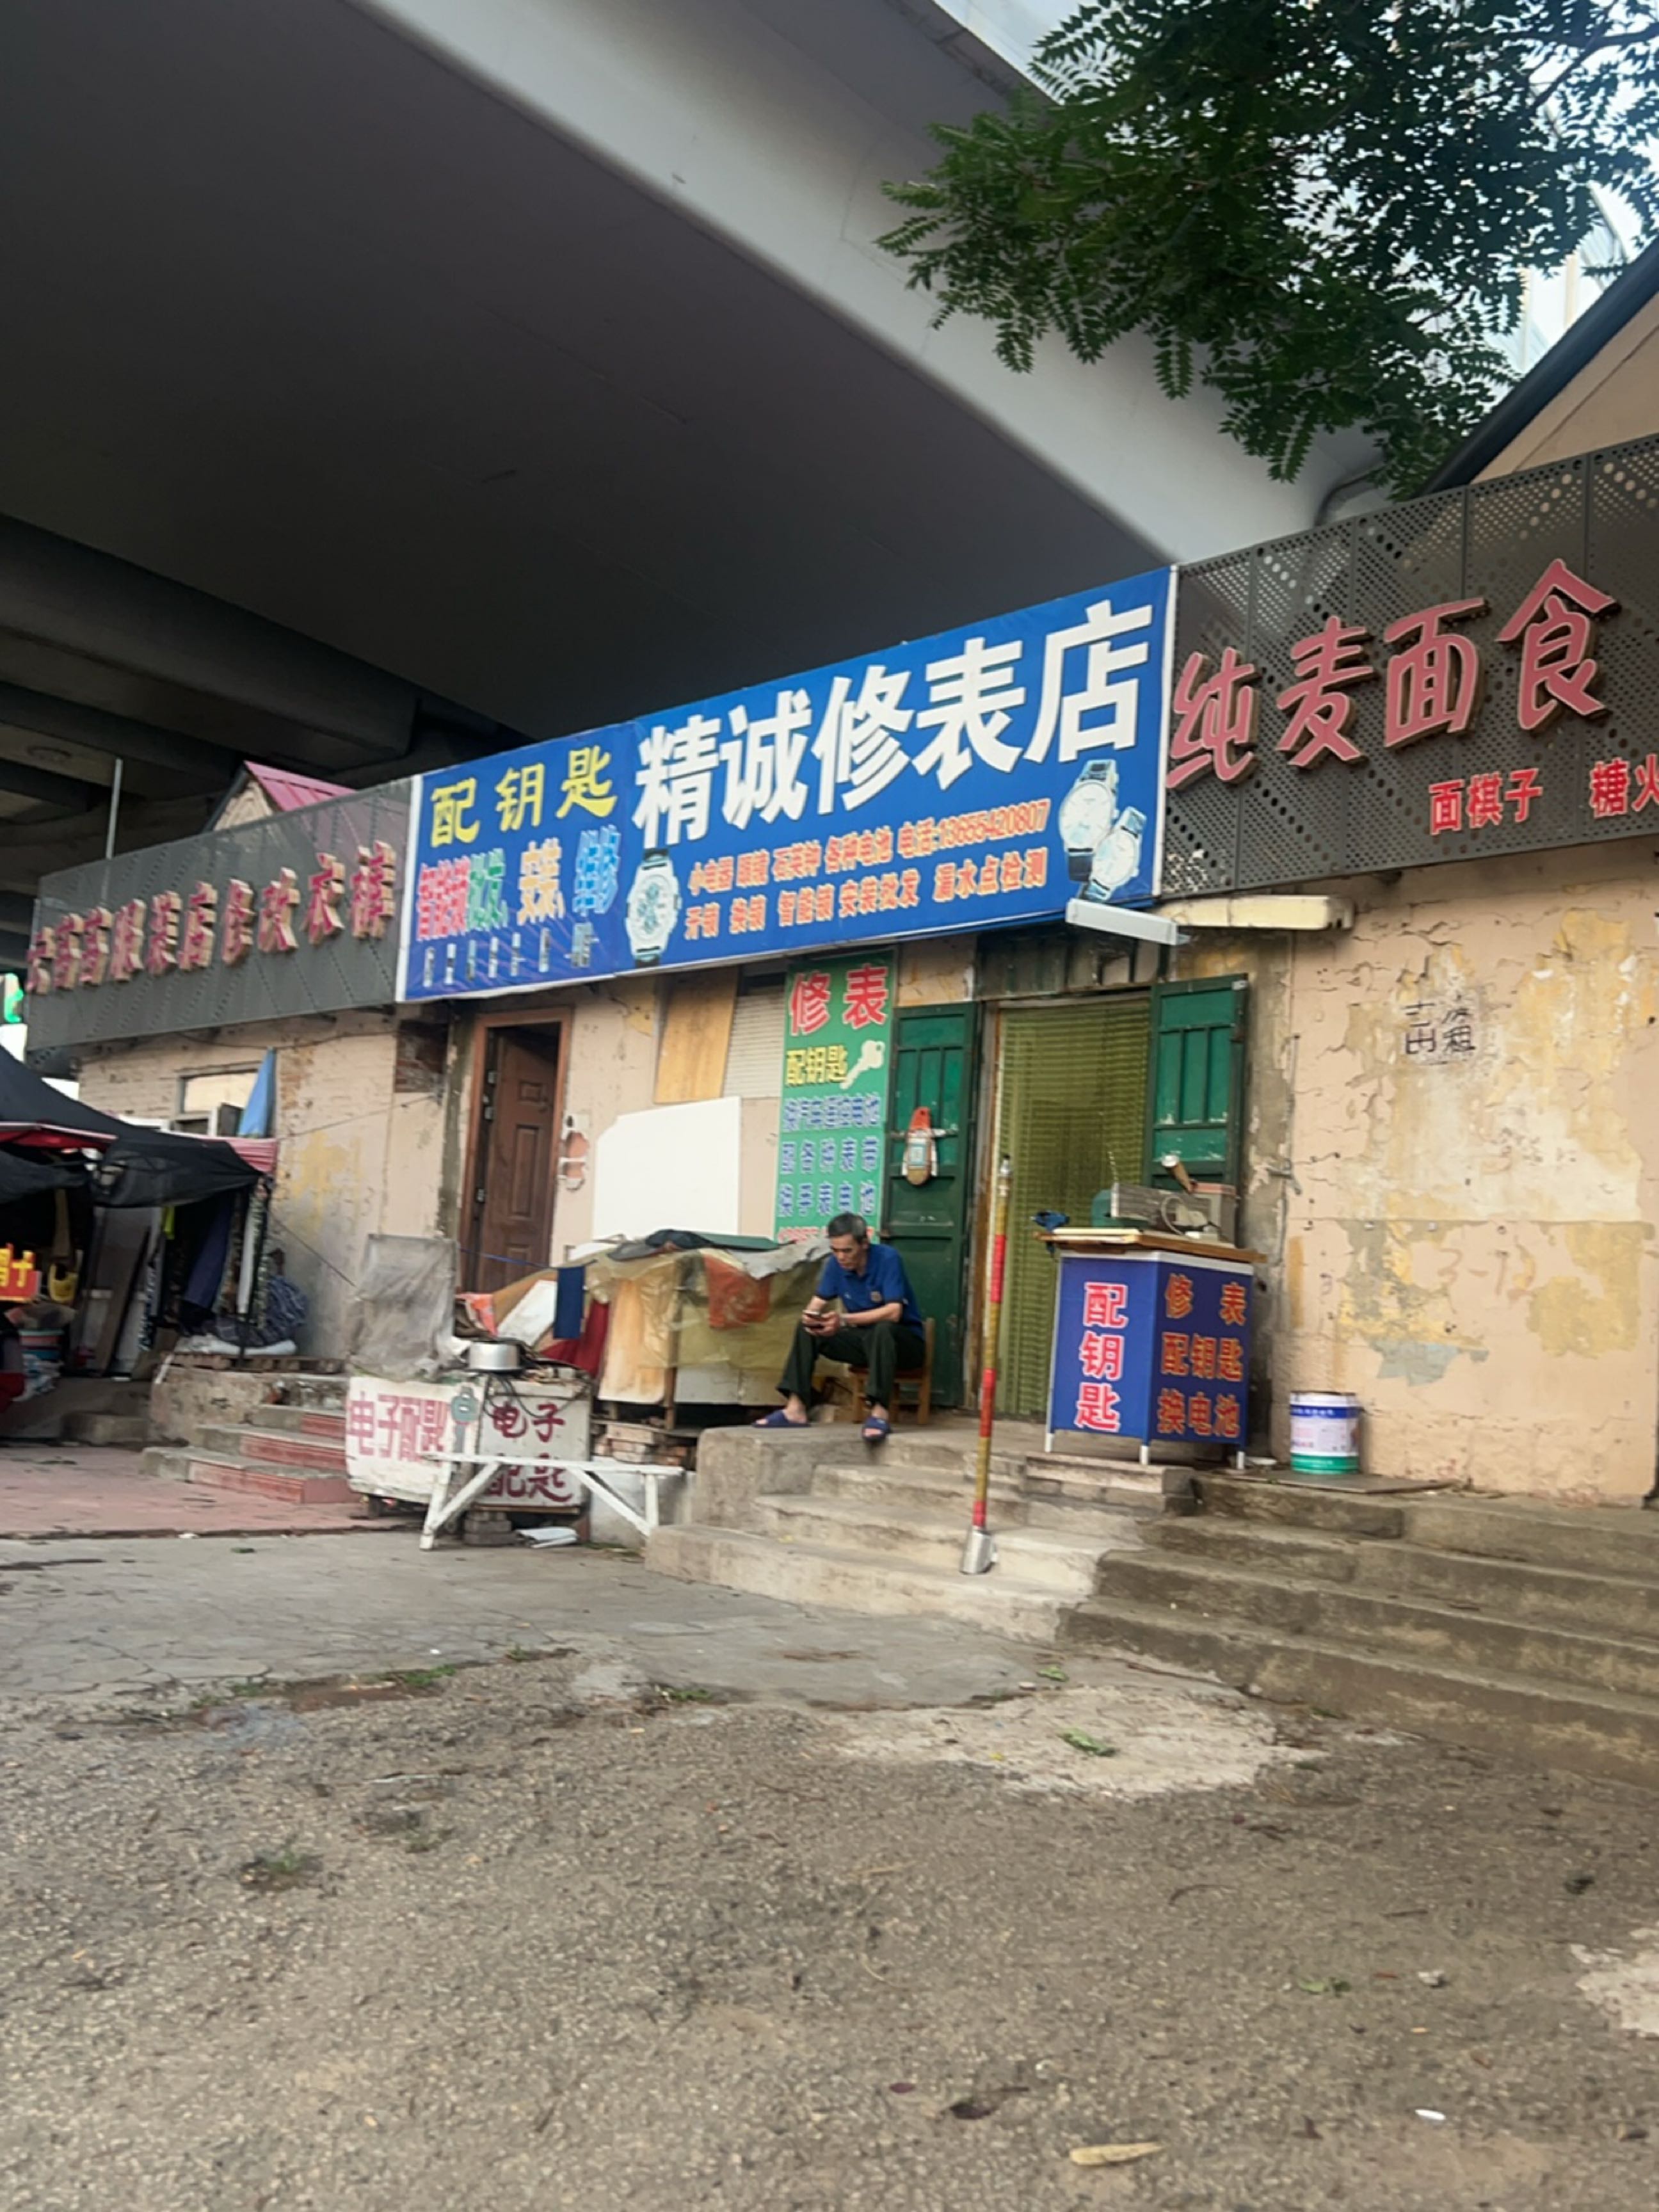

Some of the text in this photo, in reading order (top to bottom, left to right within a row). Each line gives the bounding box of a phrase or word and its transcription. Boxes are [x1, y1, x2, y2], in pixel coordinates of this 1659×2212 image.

[1166, 558, 1616, 789] 纯麦面食
[632, 600, 1153, 848] 精诚修表店
[430, 746, 618, 848] 配钥匙
[1428, 767, 1543, 836] 面棋子
[788, 963, 889, 1037] 修表
[785, 1045, 848, 1087] 配钥匙
[1165, 1272, 1247, 1326] 修表
[1075, 1282, 1129, 1432] 配钥匙
[1160, 1331, 1244, 1382] 配钥匙
[492, 1400, 565, 1443] 电子
[1157, 1388, 1240, 1438] 换电池
